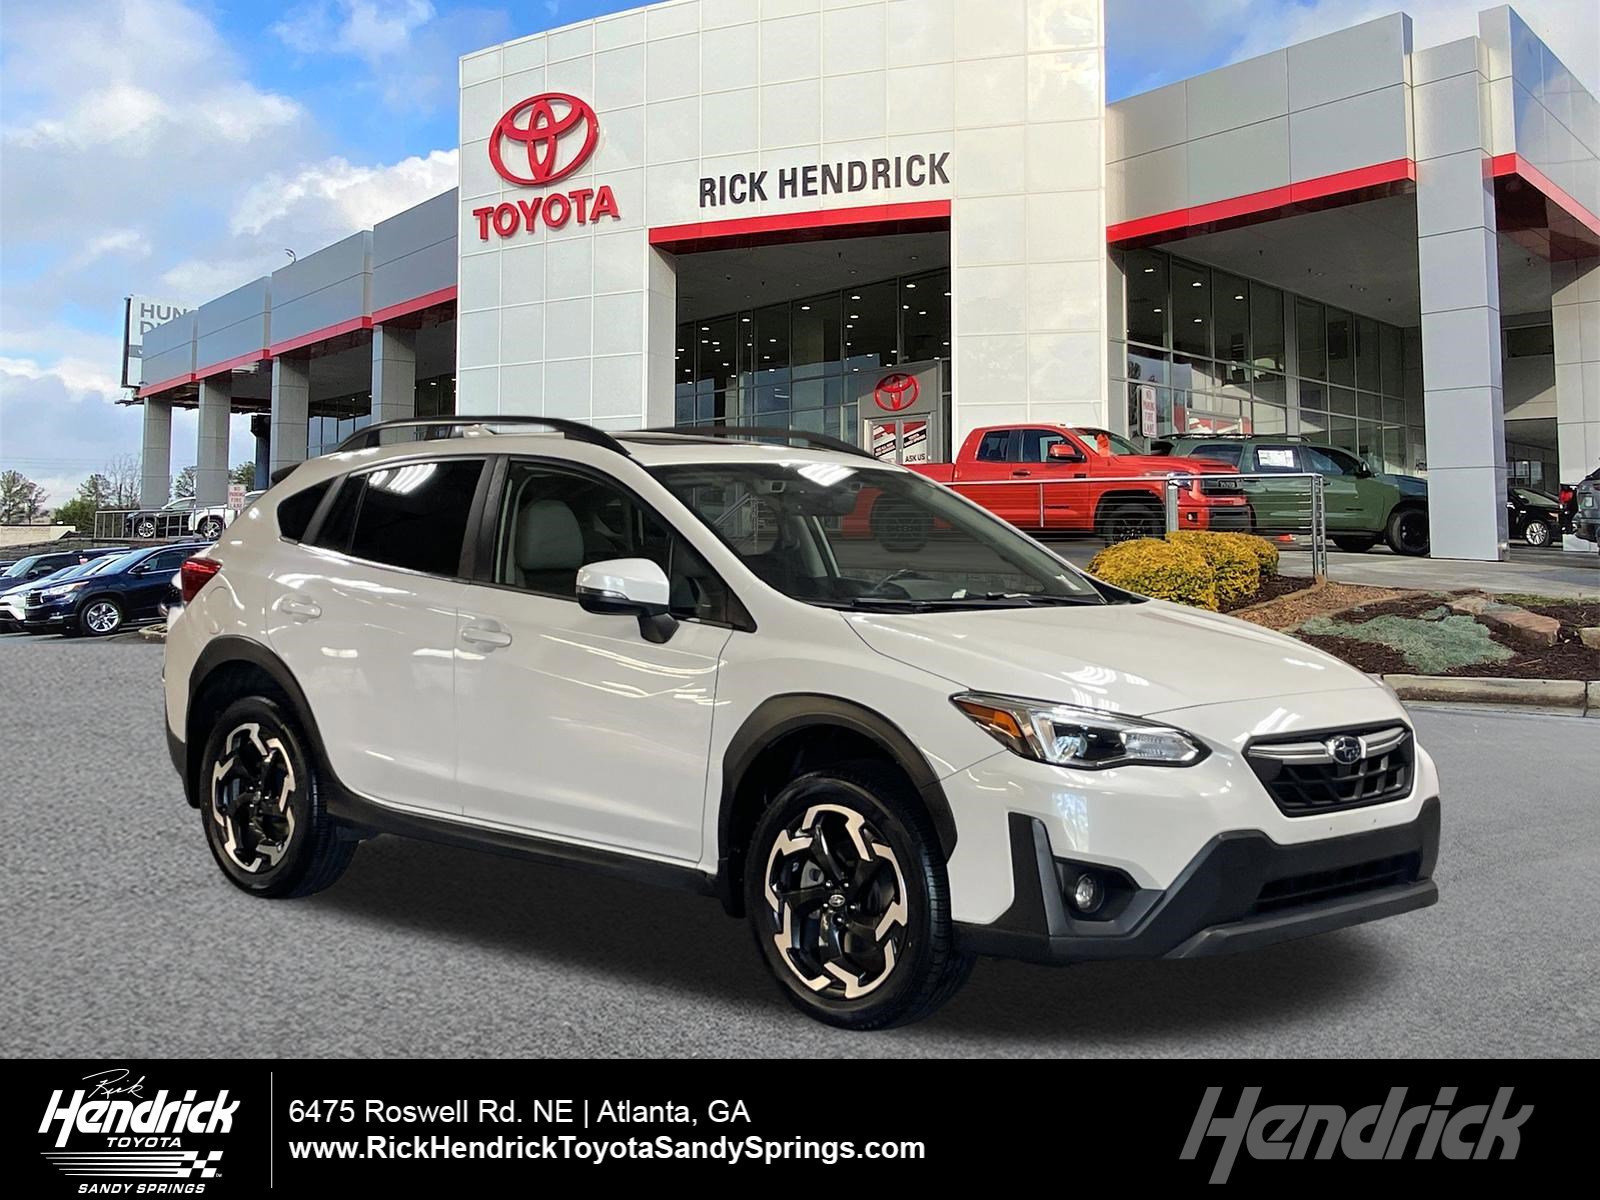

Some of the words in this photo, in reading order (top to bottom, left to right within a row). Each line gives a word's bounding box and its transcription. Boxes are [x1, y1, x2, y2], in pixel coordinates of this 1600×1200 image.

[699, 171, 768, 208] RICK
[778, 152, 950, 199] HENDRICK
[472, 185, 621, 241] TOYOTA
[904, 455, 917, 463] ASK
[918, 453, 926, 461] US
